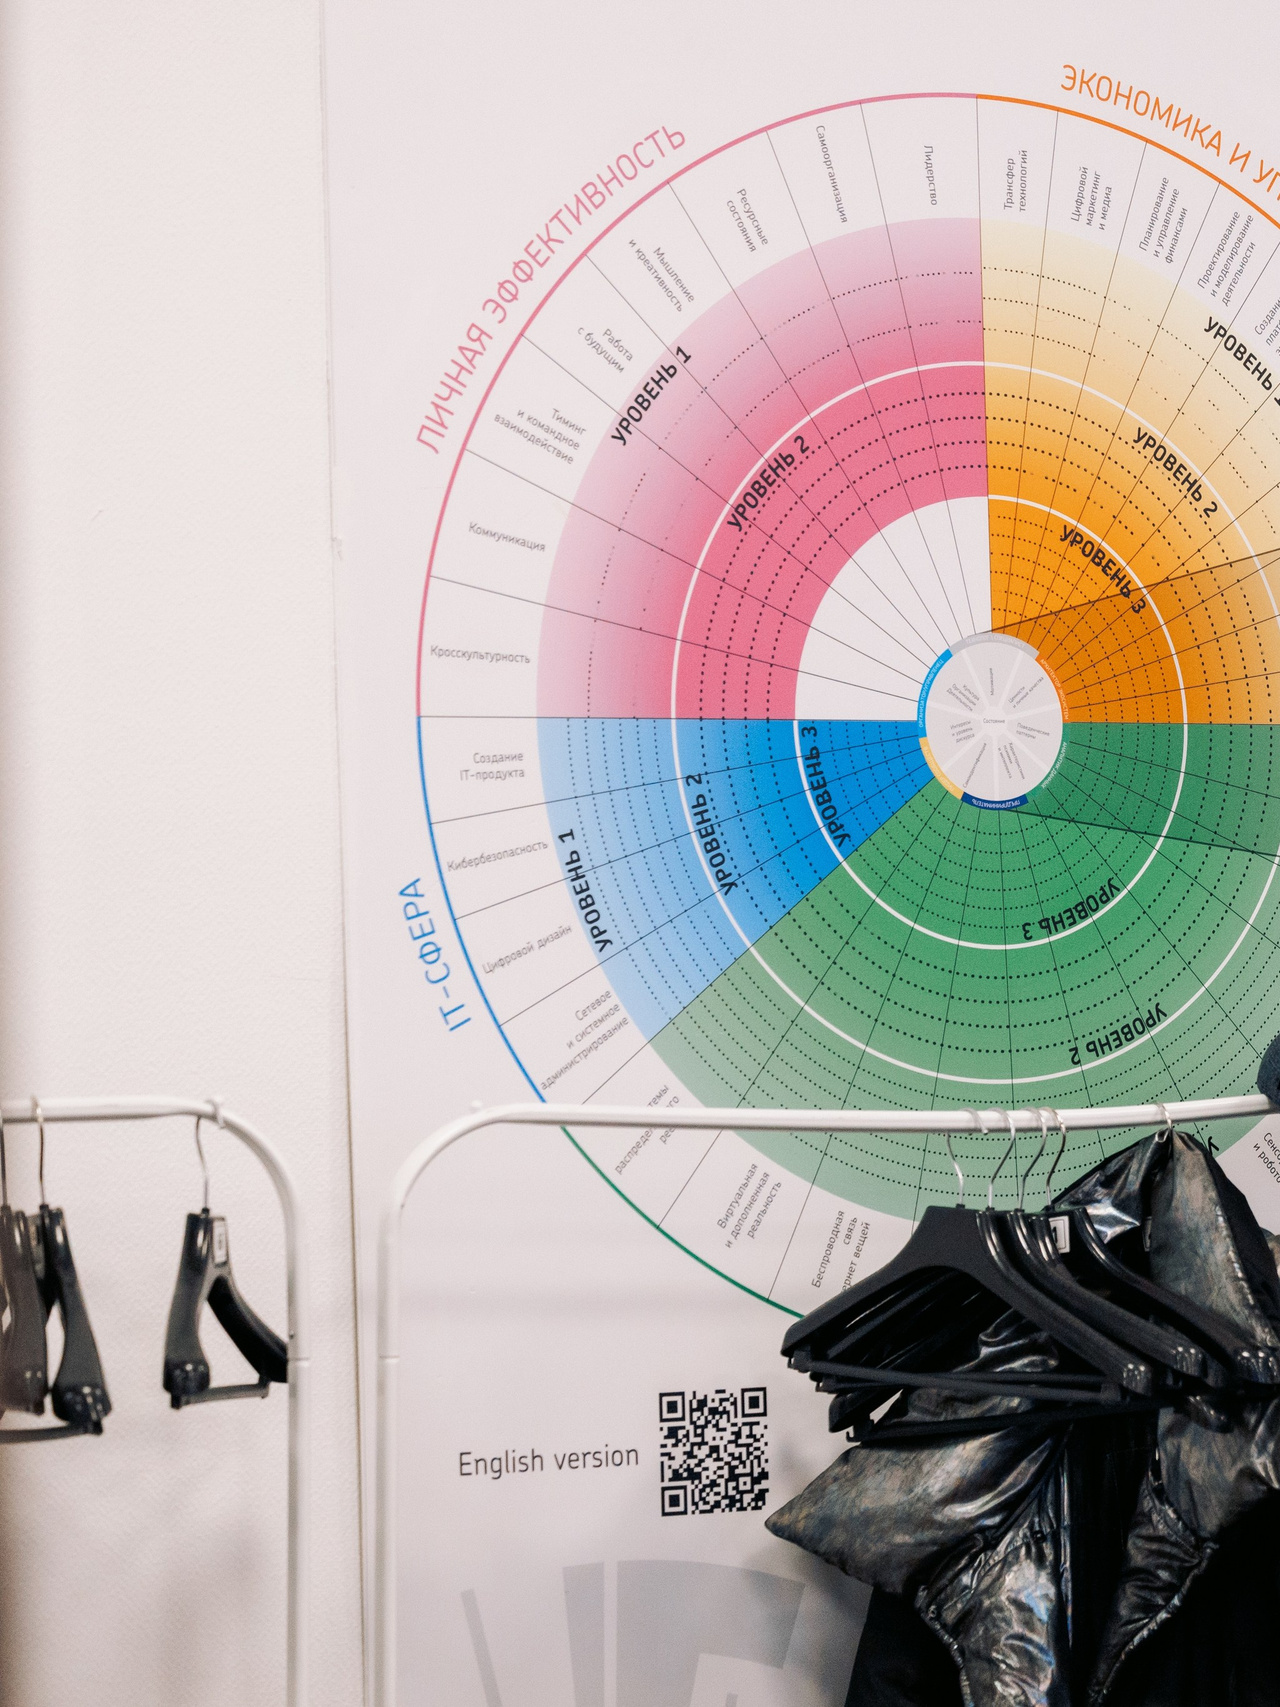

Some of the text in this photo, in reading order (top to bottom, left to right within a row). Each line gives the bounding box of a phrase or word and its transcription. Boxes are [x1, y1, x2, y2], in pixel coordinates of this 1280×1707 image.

[1062, 64, 1222, 156] ЭКОНОМИКА
[1229, 143, 1252, 172] И
[815, 125, 848, 223] Самоорганизация
[923, 145, 937, 206] Лидерство
[1003, 158, 1016, 210] Трансфер
[1018, 150, 1028, 212] технологий
[1070, 166, 1088, 222] Цифровой
[1086, 170, 1101, 226] маркетинг
[726, 200, 756, 252] состояния
[736, 188, 768, 245] Ресурсные
[1138, 177, 1169, 251] Планирование
[1164, 207, 1188, 264] финансами
[653, 247, 694, 303] Мышление
[1197, 211, 1240, 289] Проектирование
[1221, 241, 1256, 307] деятельности
[416, 125, 686, 453] ЛИЧНАЯ ЭФФЕКТИВНОСТЬ
[1204, 317, 1273, 392] УРОВЕНЬ
[612, 346, 691, 447] УРОВЕНЬ 1
[727, 434, 810, 532] УРОВЕНЬ 2
[1133, 427, 1219, 518] УРОВЕНЬ 2
[468, 522, 546, 552] Коммуникация
[1059, 525, 1147, 614] УРОВЕНЬ 3
[430, 645, 530, 664] Кросскультурность
[460, 769, 525, 782] IT-продукта
[473, 752, 524, 764] Создание
[802, 726, 850, 847] УРОВЕНЬ 3
[446, 841, 548, 872] Кибербезопасность
[687, 774, 738, 895] УРОВЕНЬ 2
[558, 828, 612, 952] УРОВЕНЬ 1
[1022, 878, 1120, 941] УРОВЕНЬ 3
[399, 878, 471, 1031] IT-СФЕРА
[482, 925, 572, 974] Цифровой дизайн
[1069, 1002, 1167, 1065] УРОВЕНЬ 2
[1253, 1142, 1261, 1151] и
[716, 1163, 758, 1229] Виртуальная
[747, 1182, 782, 1239] реальность
[811, 1210, 845, 1288] Беспроводная
[843, 1217, 857, 1245] связь
[459, 1443, 638, 1480] English version
